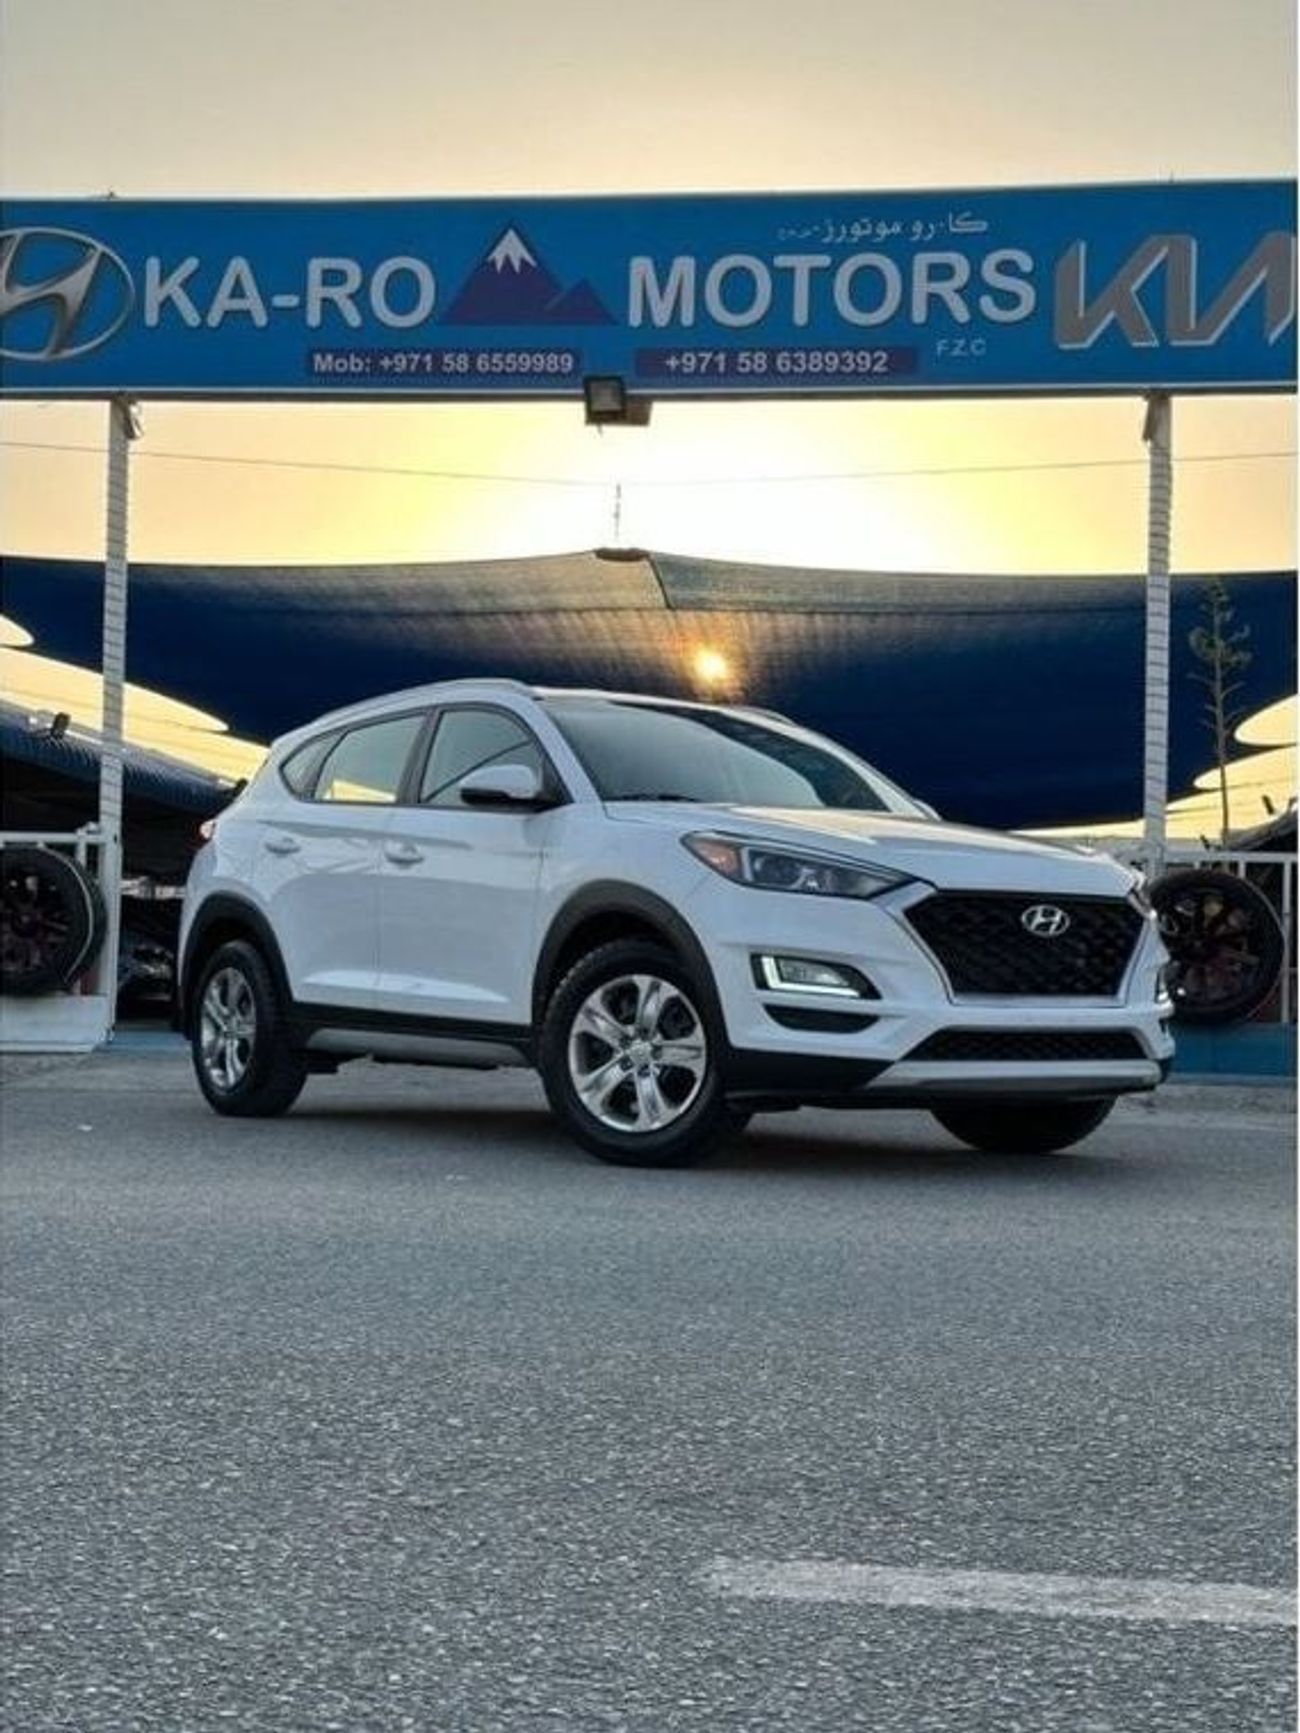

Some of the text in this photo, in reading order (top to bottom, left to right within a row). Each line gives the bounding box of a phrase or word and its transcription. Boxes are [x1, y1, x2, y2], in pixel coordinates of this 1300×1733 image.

[143, 248, 1036, 329] KA-RO MOTORS
[936, 338, 987, 357] FZC
[313, 352, 574, 374] Mob: +971 58 6559989
[665, 350, 888, 374] +971 58 6389392
